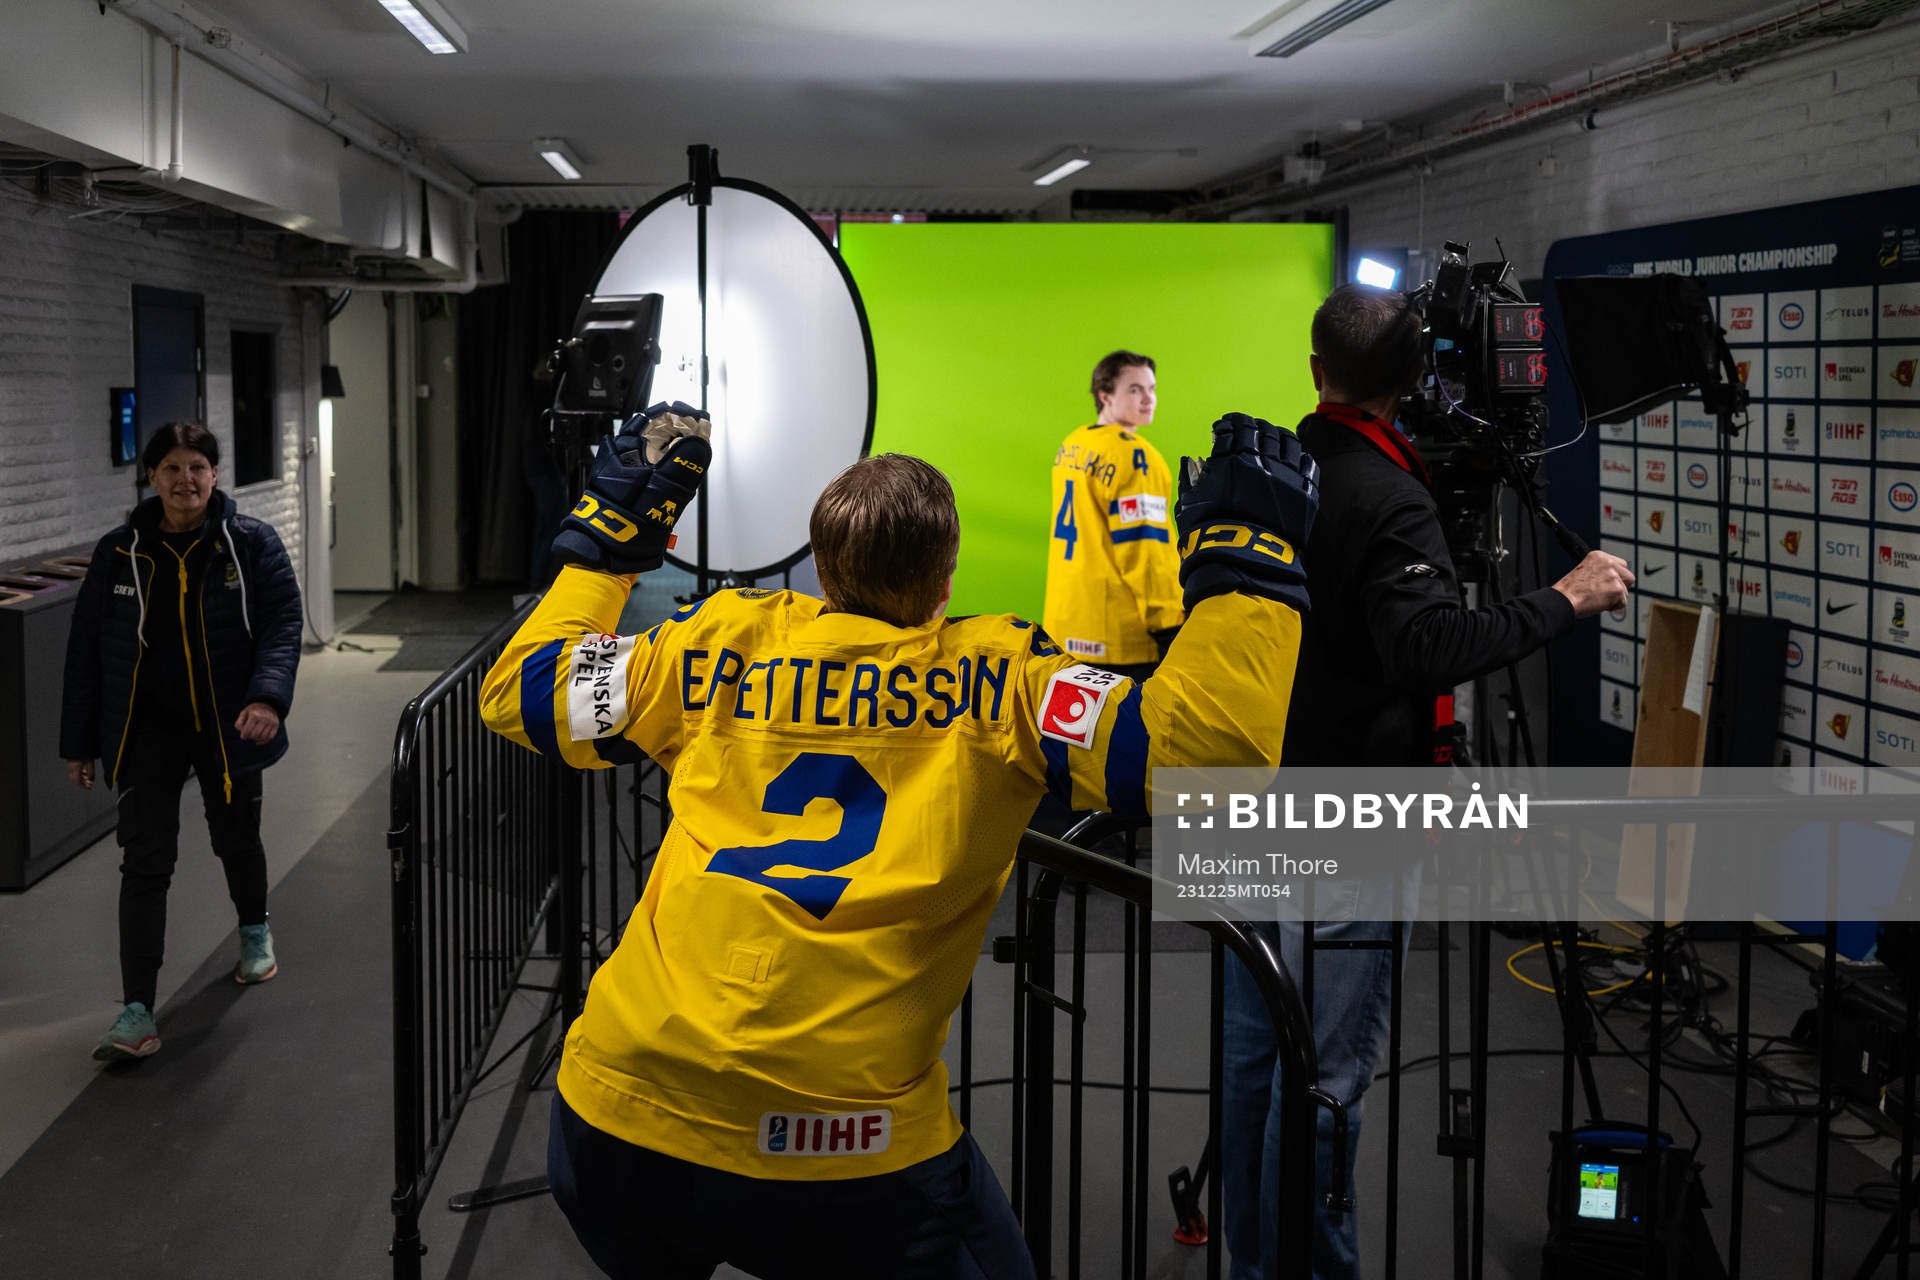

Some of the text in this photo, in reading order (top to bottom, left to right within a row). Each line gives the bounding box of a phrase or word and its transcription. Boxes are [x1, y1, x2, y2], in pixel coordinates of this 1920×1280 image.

[1655, 258, 1693, 276] WORLD
[1694, 254, 1736, 276] JUNIOR
[1738, 243, 1838, 272] CHAMPIONSHIP
[1841, 308, 1869, 317] TELUS
[1775, 367, 1807, 379] SOTI
[1647, 415, 1669, 429] IIHF
[1834, 423, 1865, 440] IIHF
[673, 457, 704, 474] CCM
[1133, 448, 1149, 476] 4
[1831, 479, 1858, 491] TSN
[1893, 489, 1913, 503] Esso
[1053, 480, 1077, 561] 4
[1685, 519, 1712, 535] SOTI
[1826, 541, 1860, 558] SOTI
[1893, 560, 1909, 568] SPEL
[113, 584, 136, 597] CREW
[575, 642, 598, 687] SPEL
[1837, 663, 1863, 675] TELUS
[1875, 670, 1888, 684] Tim
[593, 640, 617, 735] SVENSKA
[1876, 730, 1915, 752] SOTI
[1828, 773, 1857, 793] IIHF
[704, 752, 887, 920] 2
[795, 1115, 882, 1151] IIHF
